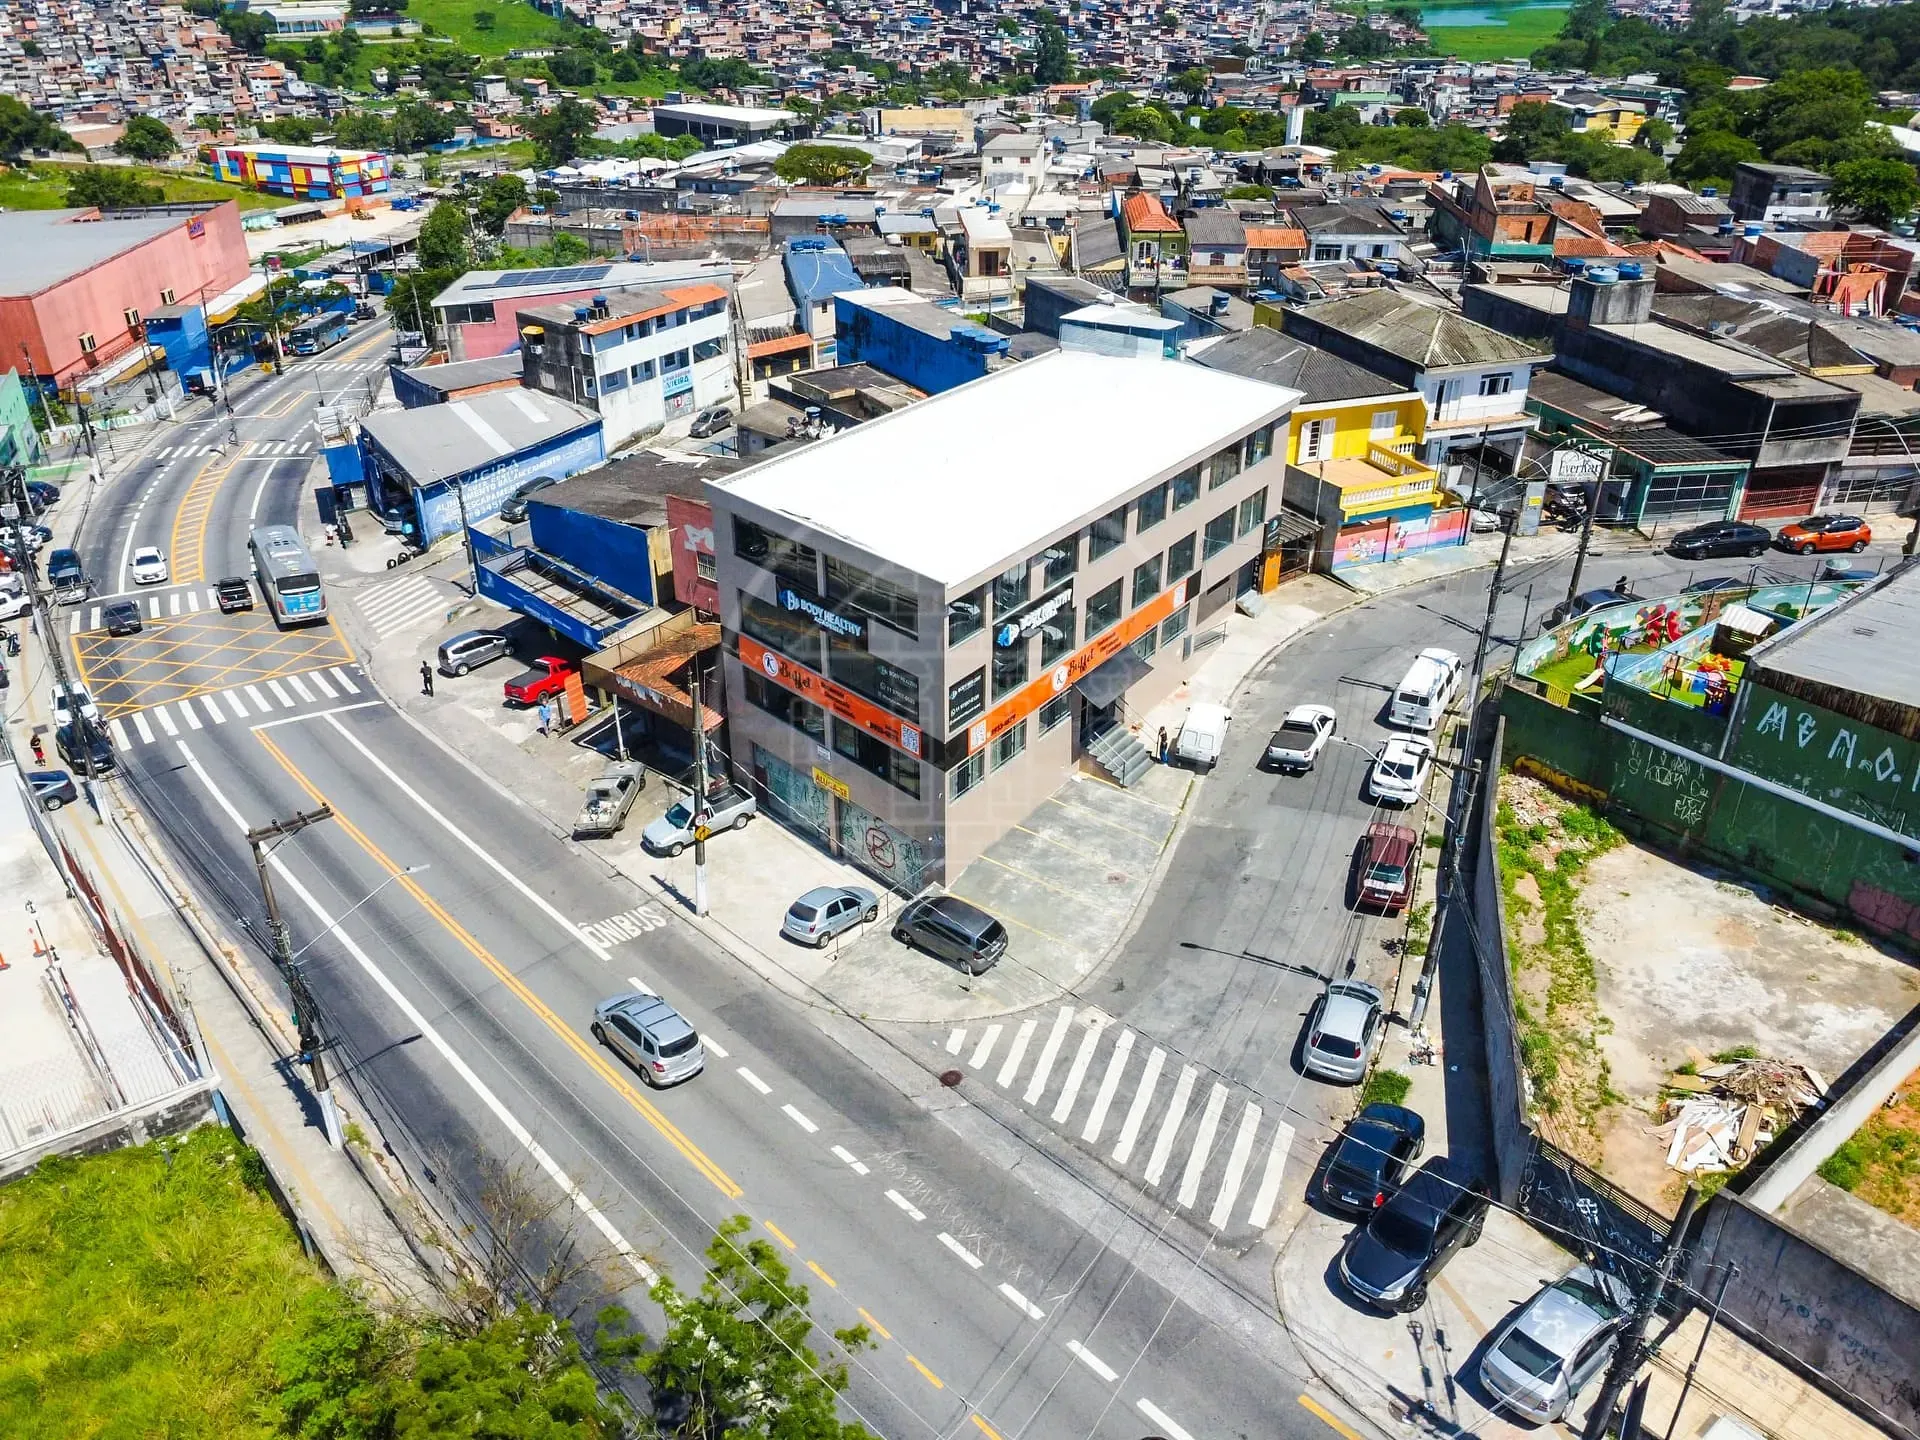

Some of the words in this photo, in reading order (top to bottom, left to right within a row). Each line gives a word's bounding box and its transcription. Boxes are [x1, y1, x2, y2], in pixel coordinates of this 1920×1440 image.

[666, 375, 689, 388] VIEIRA
[801, 599, 823, 618] BODY
[824, 609, 861, 637] HEALTHY
[577, 905, 667, 948] ÔNIBUS
